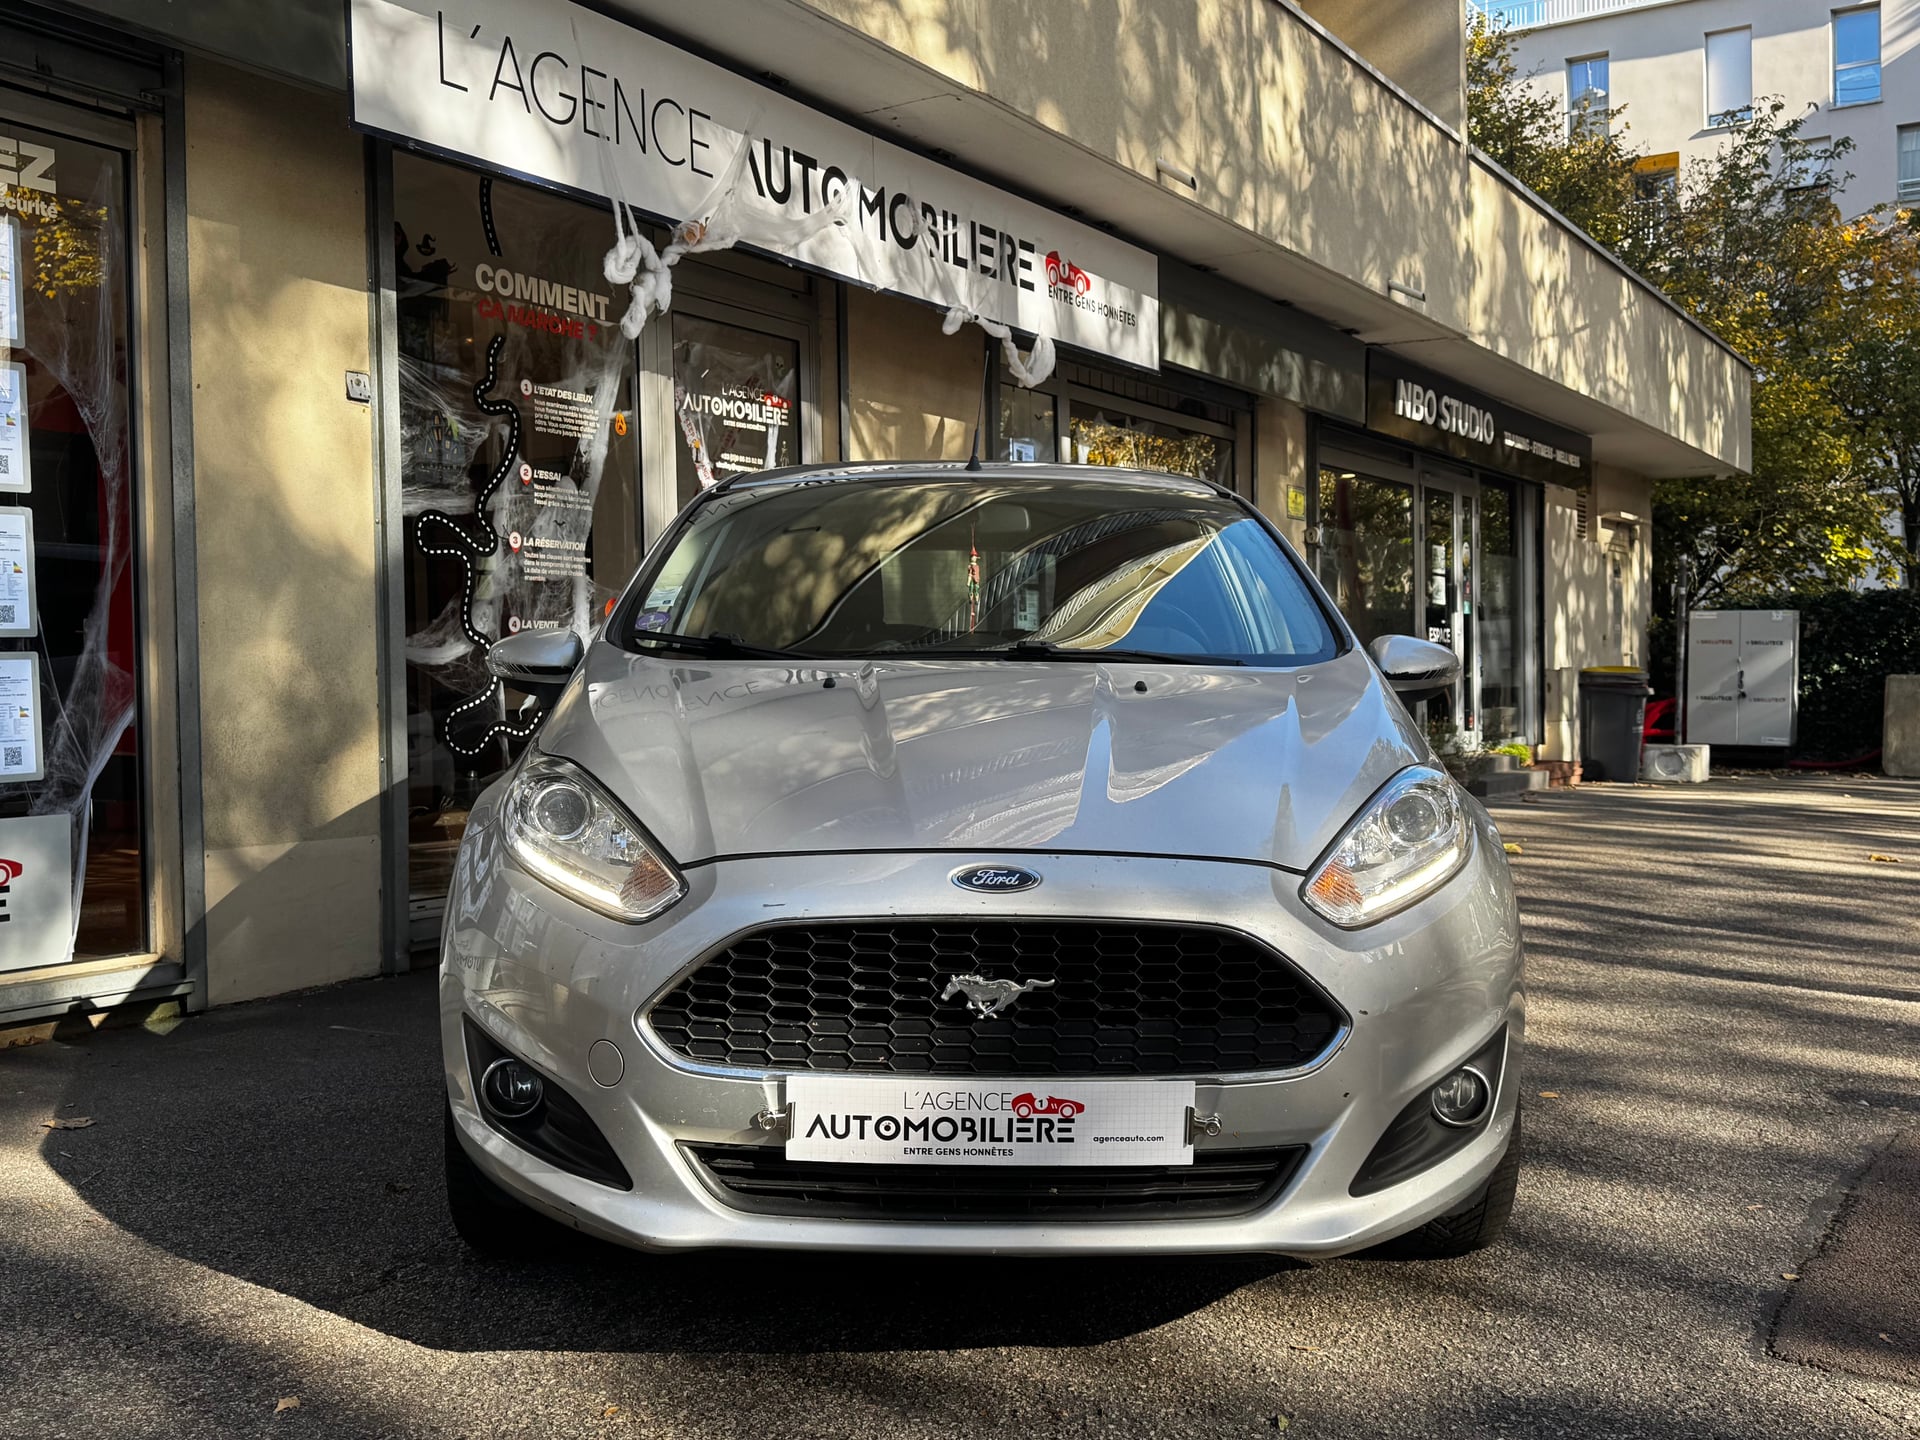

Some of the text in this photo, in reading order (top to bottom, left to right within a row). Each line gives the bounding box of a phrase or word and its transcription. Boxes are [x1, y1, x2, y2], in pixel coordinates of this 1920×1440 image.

[437, 10, 714, 179] L'AGENCE
[475, 263, 610, 321] COMMENT
[1048, 284, 1136, 327] ENTRE GENS HONNÊTES
[508, 304, 585, 340] MARCHE
[587, 324, 598, 342] ?
[557, 389, 572, 400] DES
[572, 392, 594, 404] LIEUX
[722, 382, 765, 402] L'AGENCE
[682, 392, 790, 426] AUTOMOBILIERE
[1394, 378, 1437, 426] NBO
[1440, 395, 1495, 446] STUDIO
[533, 468, 562, 482] L'ESSAI
[523, 537, 534, 547] LA
[535, 537, 586, 552] RÉSERVATION
[521, 620, 533, 629] LA
[533, 620, 560, 630] VENTE
[1428, 626, 1451, 644] ESPACE
[972, 868, 1020, 886] Ford
[903, 1091, 1013, 1111] L'AGENCE
[805, 1113, 1076, 1143] AUTOMOBILIERE
[1092, 1135, 1165, 1144] agenceauto.com
[903, 1146, 1014, 1157] ENTRE GENS HONNÊTES
